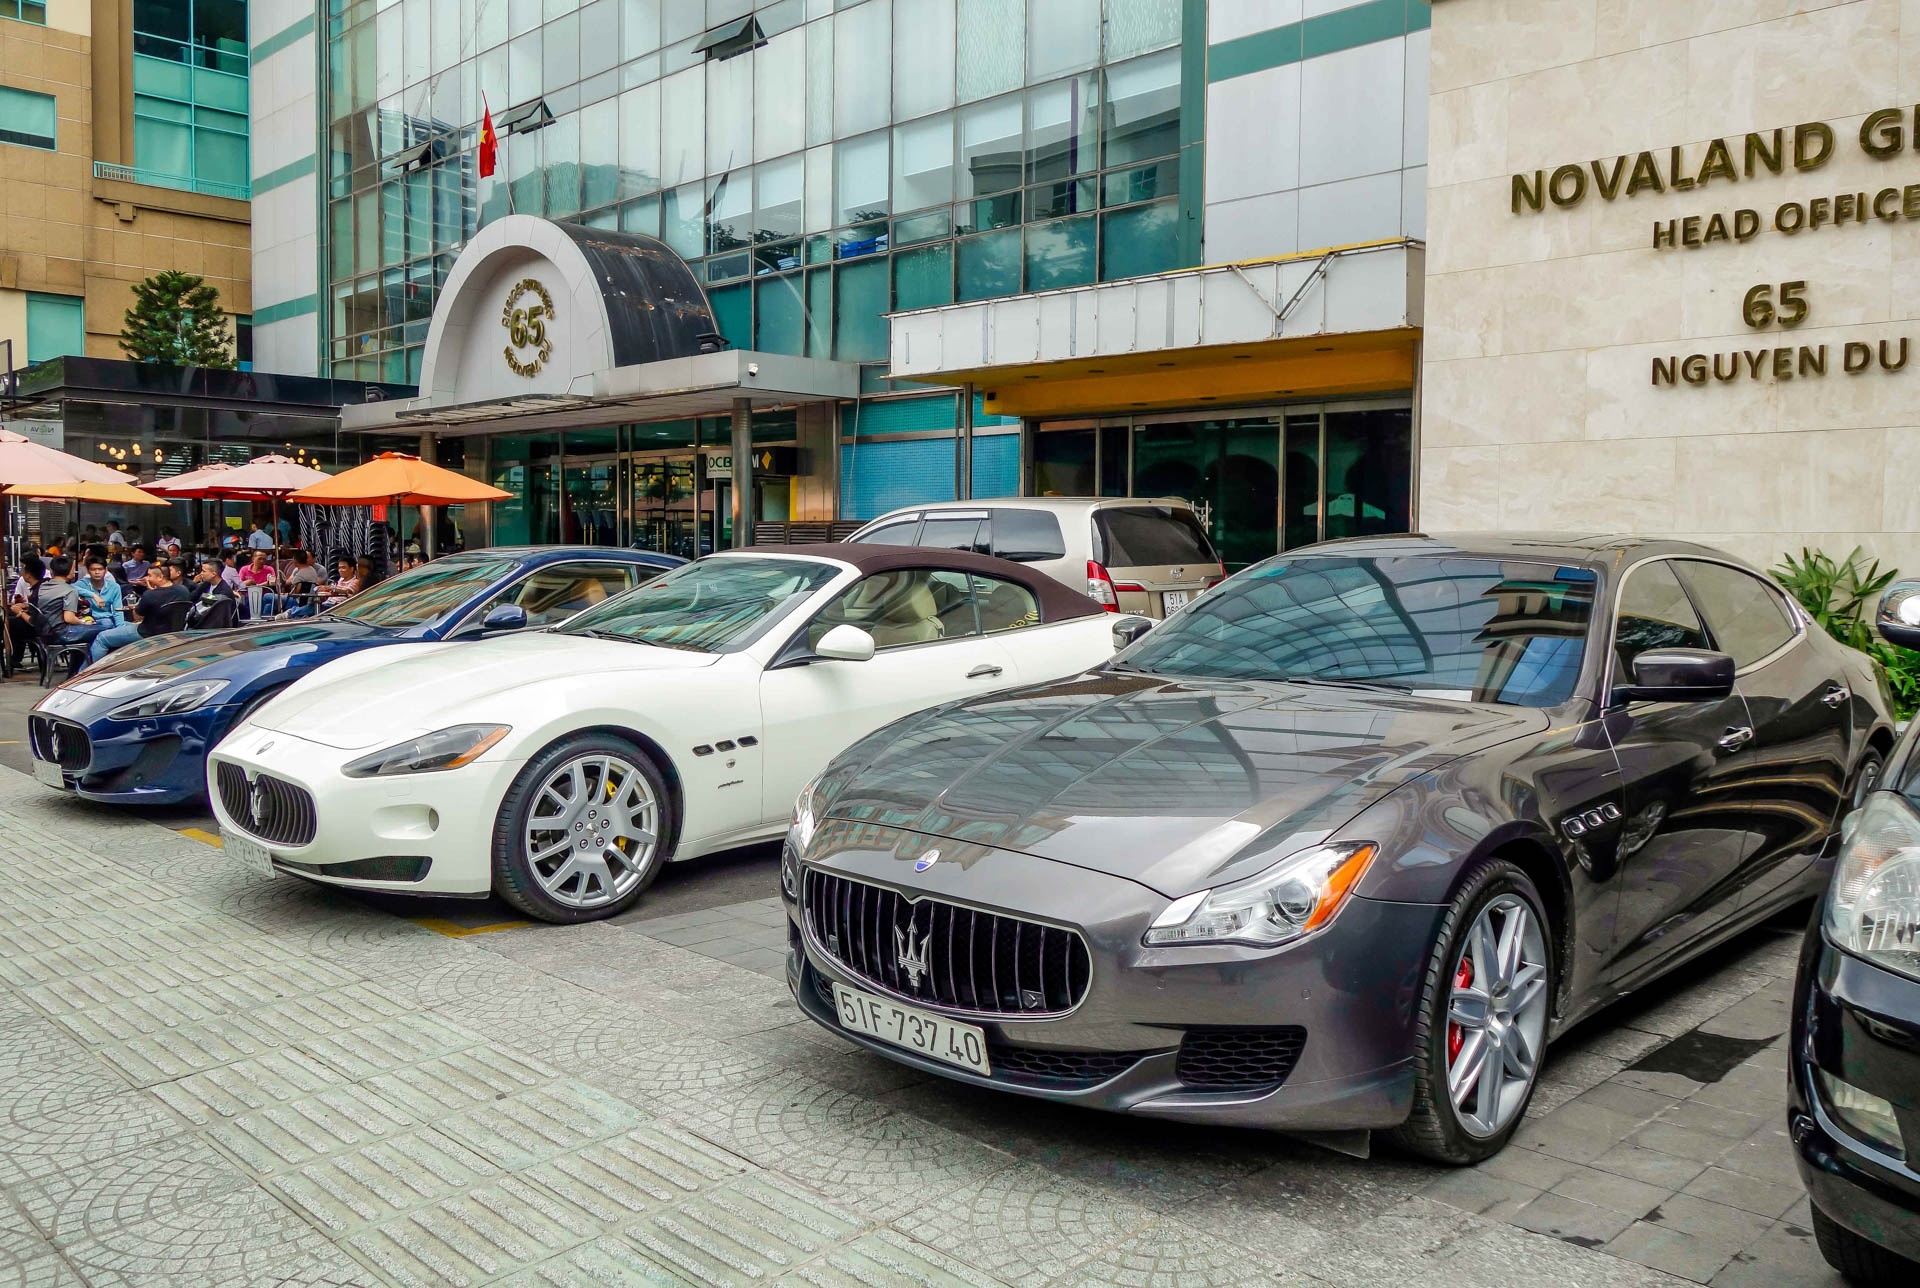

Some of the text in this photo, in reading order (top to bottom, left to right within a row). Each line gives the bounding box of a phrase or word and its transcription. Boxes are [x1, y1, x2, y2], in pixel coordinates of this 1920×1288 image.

[1511, 103, 1920, 214] NOVALAND G
[1652, 183, 1920, 250] HEAD OFFICE
[511, 305, 544, 348] 65
[1743, 280, 1809, 329] 65
[1651, 336, 1910, 387] NGUYEN DU
[708, 456, 732, 469] OCB
[1169, 593, 1184, 605] 51A
[840, 991, 982, 1066] 51F-737.40
